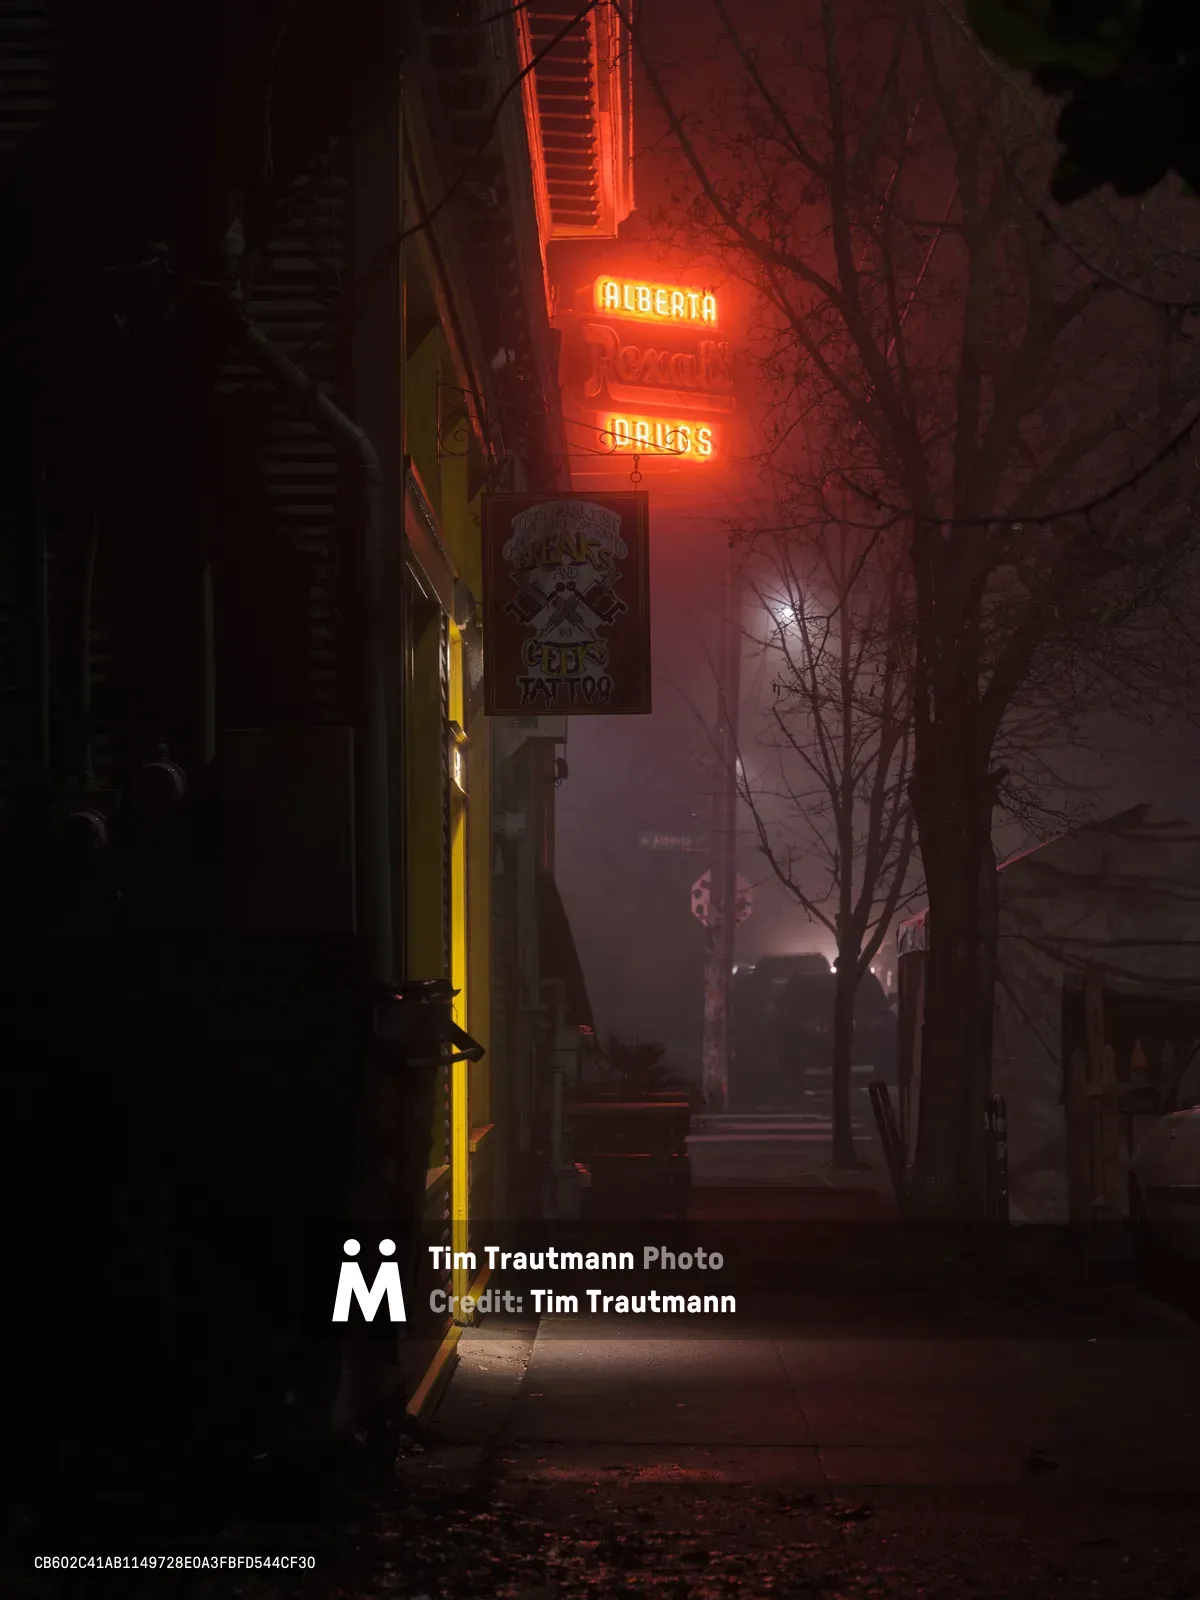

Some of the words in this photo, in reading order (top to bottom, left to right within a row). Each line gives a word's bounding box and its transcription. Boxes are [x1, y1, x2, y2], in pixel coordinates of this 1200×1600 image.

[602, 281, 717, 322] ALBERTA
[582, 323, 734, 397] Rexall
[610, 417, 713, 456] DRUGS
[551, 566, 579, 580] AND
[521, 638, 609, 678] GEEKS
[518, 673, 612, 706] TATTOO
